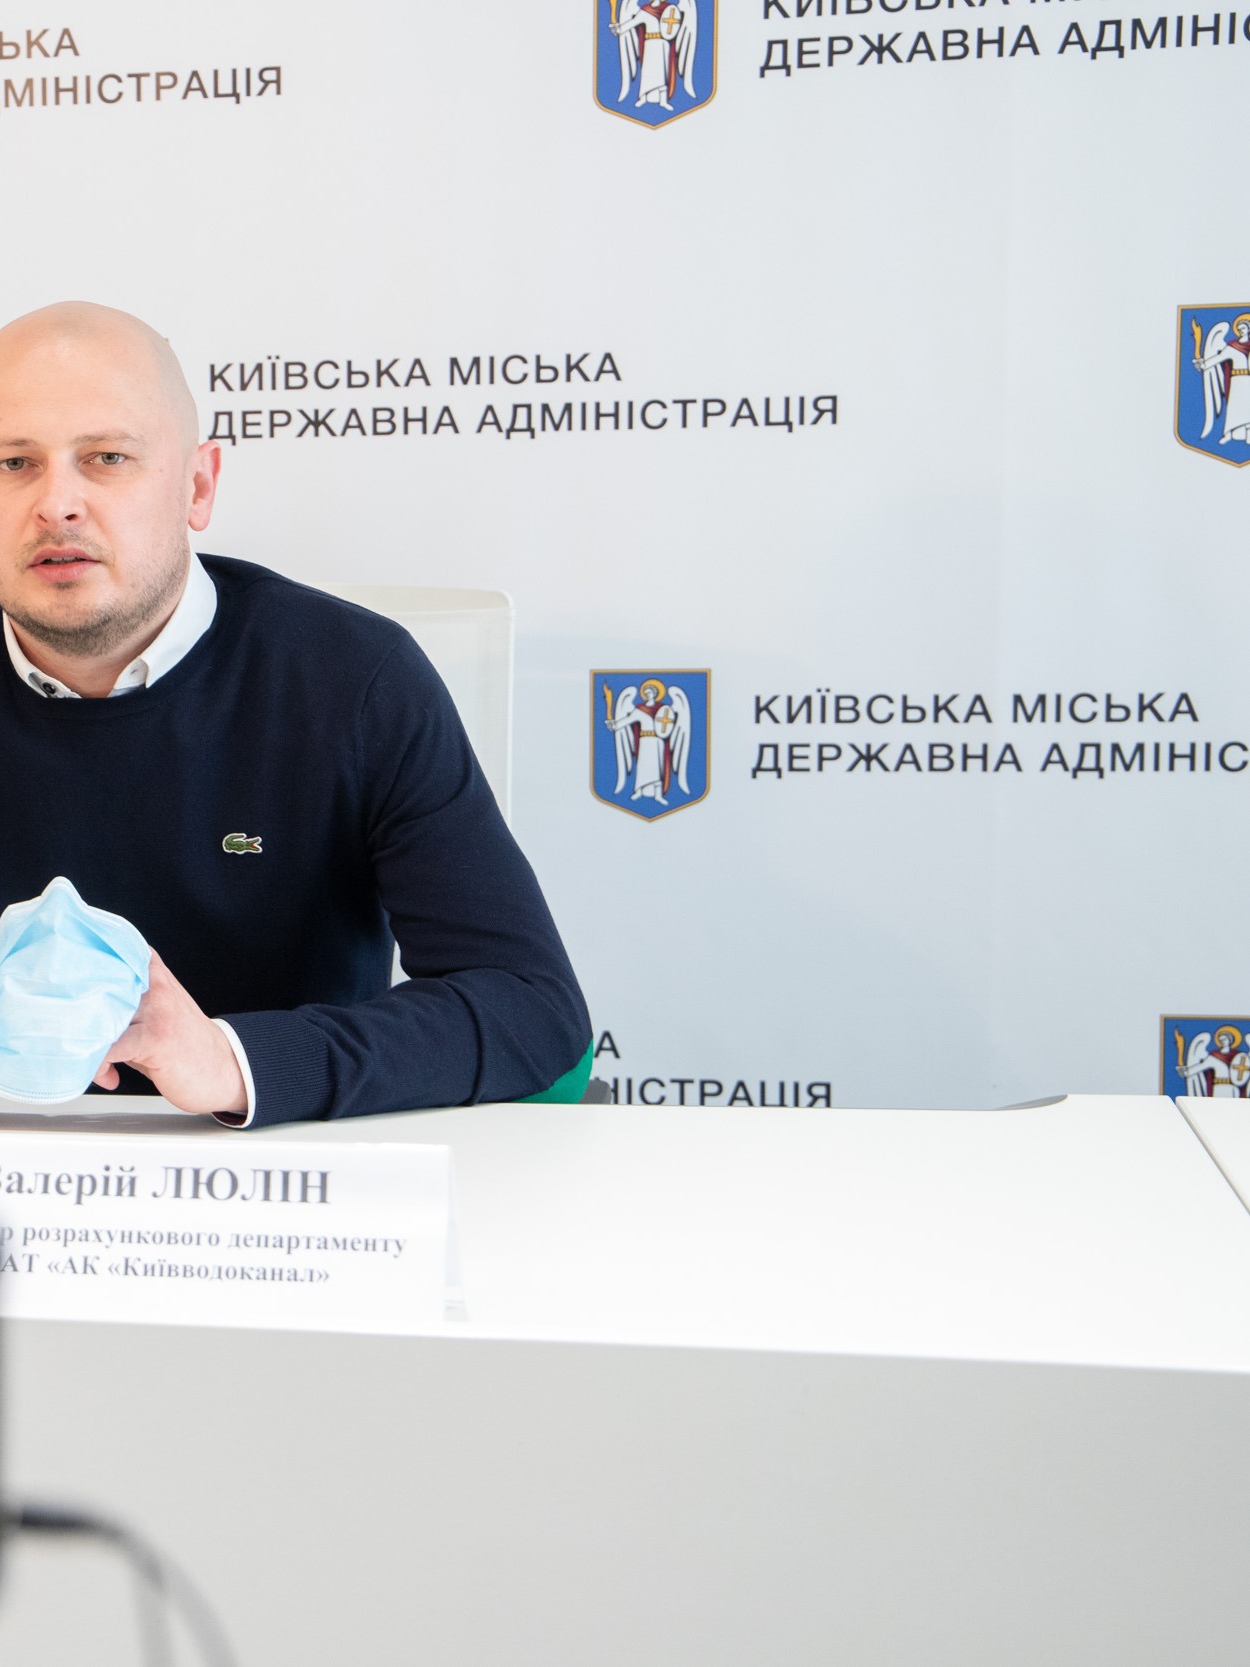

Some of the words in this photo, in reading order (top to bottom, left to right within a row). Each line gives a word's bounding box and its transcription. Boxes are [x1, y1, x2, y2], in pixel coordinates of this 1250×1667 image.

[760, 25, 1041, 79] ДЕРЖАВНА
[1058, 12, 1250, 61] АДМІНІ
[210, 355, 431, 393] КИЇВСЬКА
[450, 352, 623, 387] МІСЬКА
[208, 405, 460, 446] ДЕРЖАВНА
[476, 395, 840, 441] АДМІНІСТРАЦІЯ
[754, 688, 994, 725] КИЇВСЬКА
[1013, 692, 1200, 725] МІСЬКА
[752, 742, 1024, 781] ДЕРЖАВНА
[1041, 741, 1250, 780] АДМІНІС
[151, 1166, 332, 1204] ЛЮЛІН
[22, 1226, 220, 1249] розрахункового
[227, 1232, 407, 1258] департаменту
[47, 1255, 100, 1275] «АК
[108, 1256, 330, 1283] «Київводоканал»
